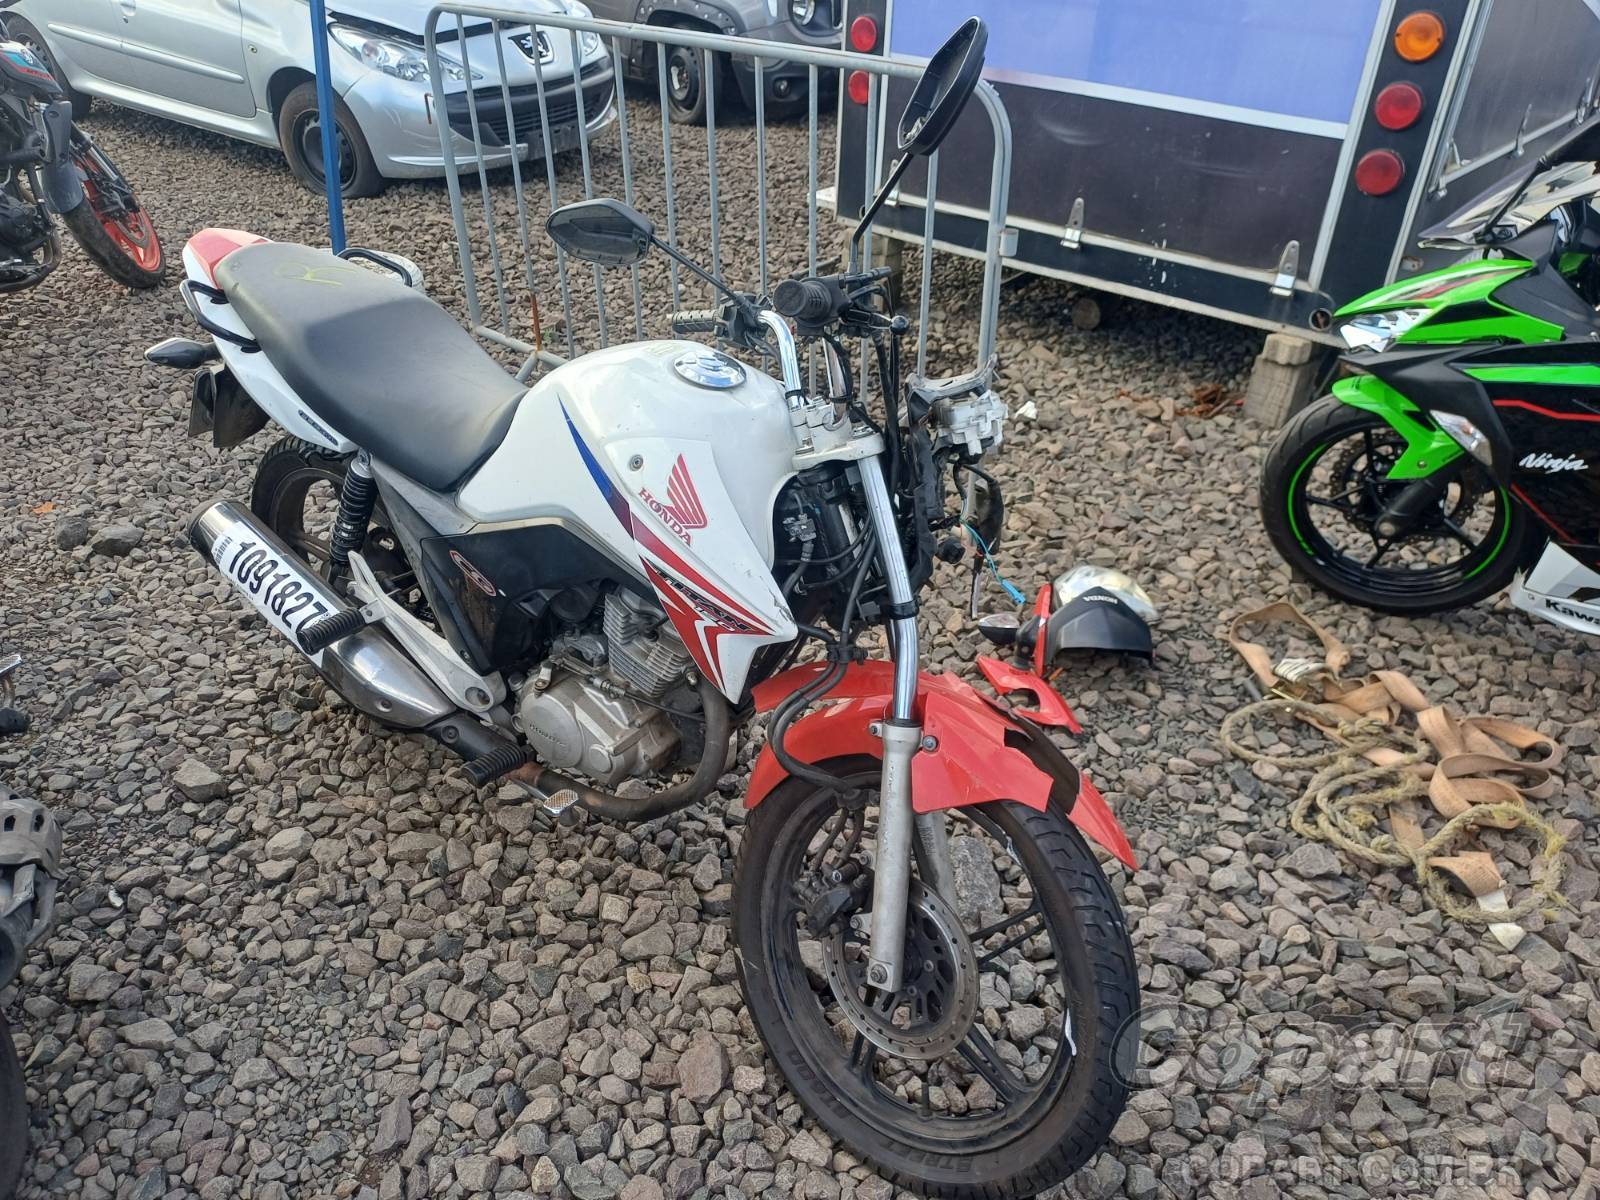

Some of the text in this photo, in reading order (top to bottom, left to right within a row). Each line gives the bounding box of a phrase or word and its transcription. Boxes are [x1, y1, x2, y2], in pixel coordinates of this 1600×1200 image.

[1518, 452, 1589, 475] Ninja
[638, 487, 692, 547] HONDA
[228, 541, 329, 635] 1091827
